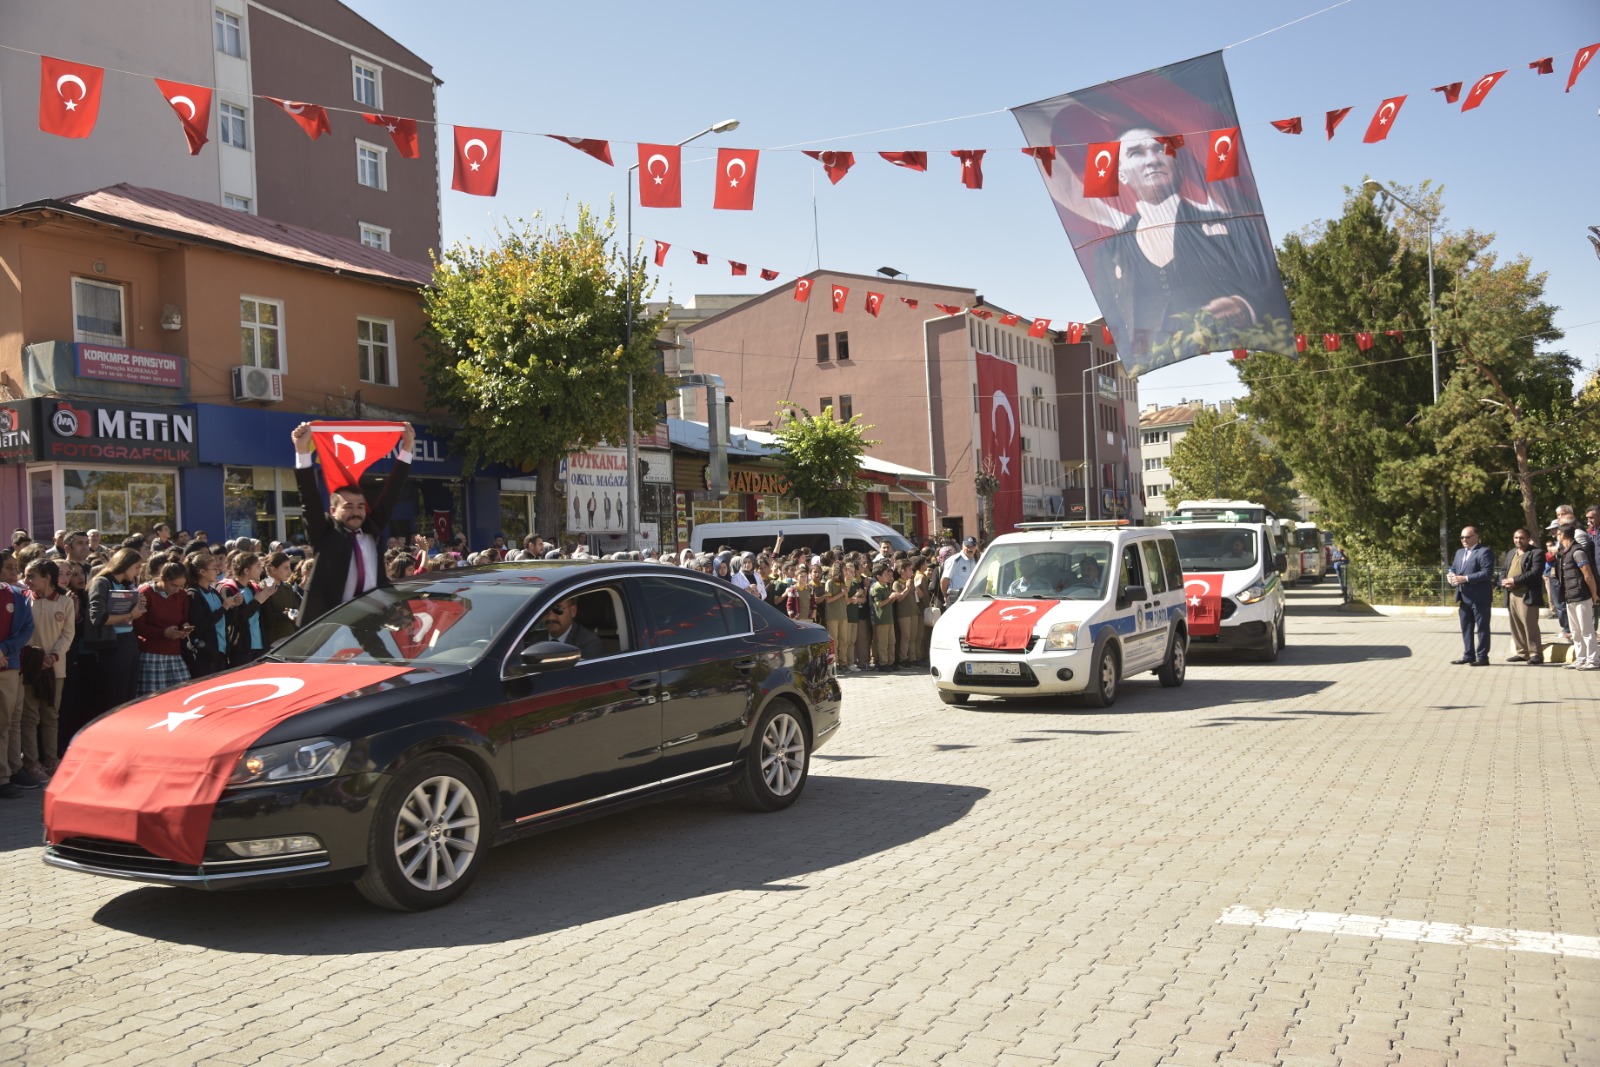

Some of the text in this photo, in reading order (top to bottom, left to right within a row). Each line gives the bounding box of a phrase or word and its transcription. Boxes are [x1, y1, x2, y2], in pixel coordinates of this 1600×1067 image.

[84, 349, 130, 364] KORKMAZ
[126, 366, 158, 375] KORKMAZ
[52, 442, 190, 463] FOTOĞRAFÇILIK
[570, 453, 628, 471] TUTKANLA
[571, 473, 595, 486] OKUL
[728, 470, 792, 495] MAYDANO
